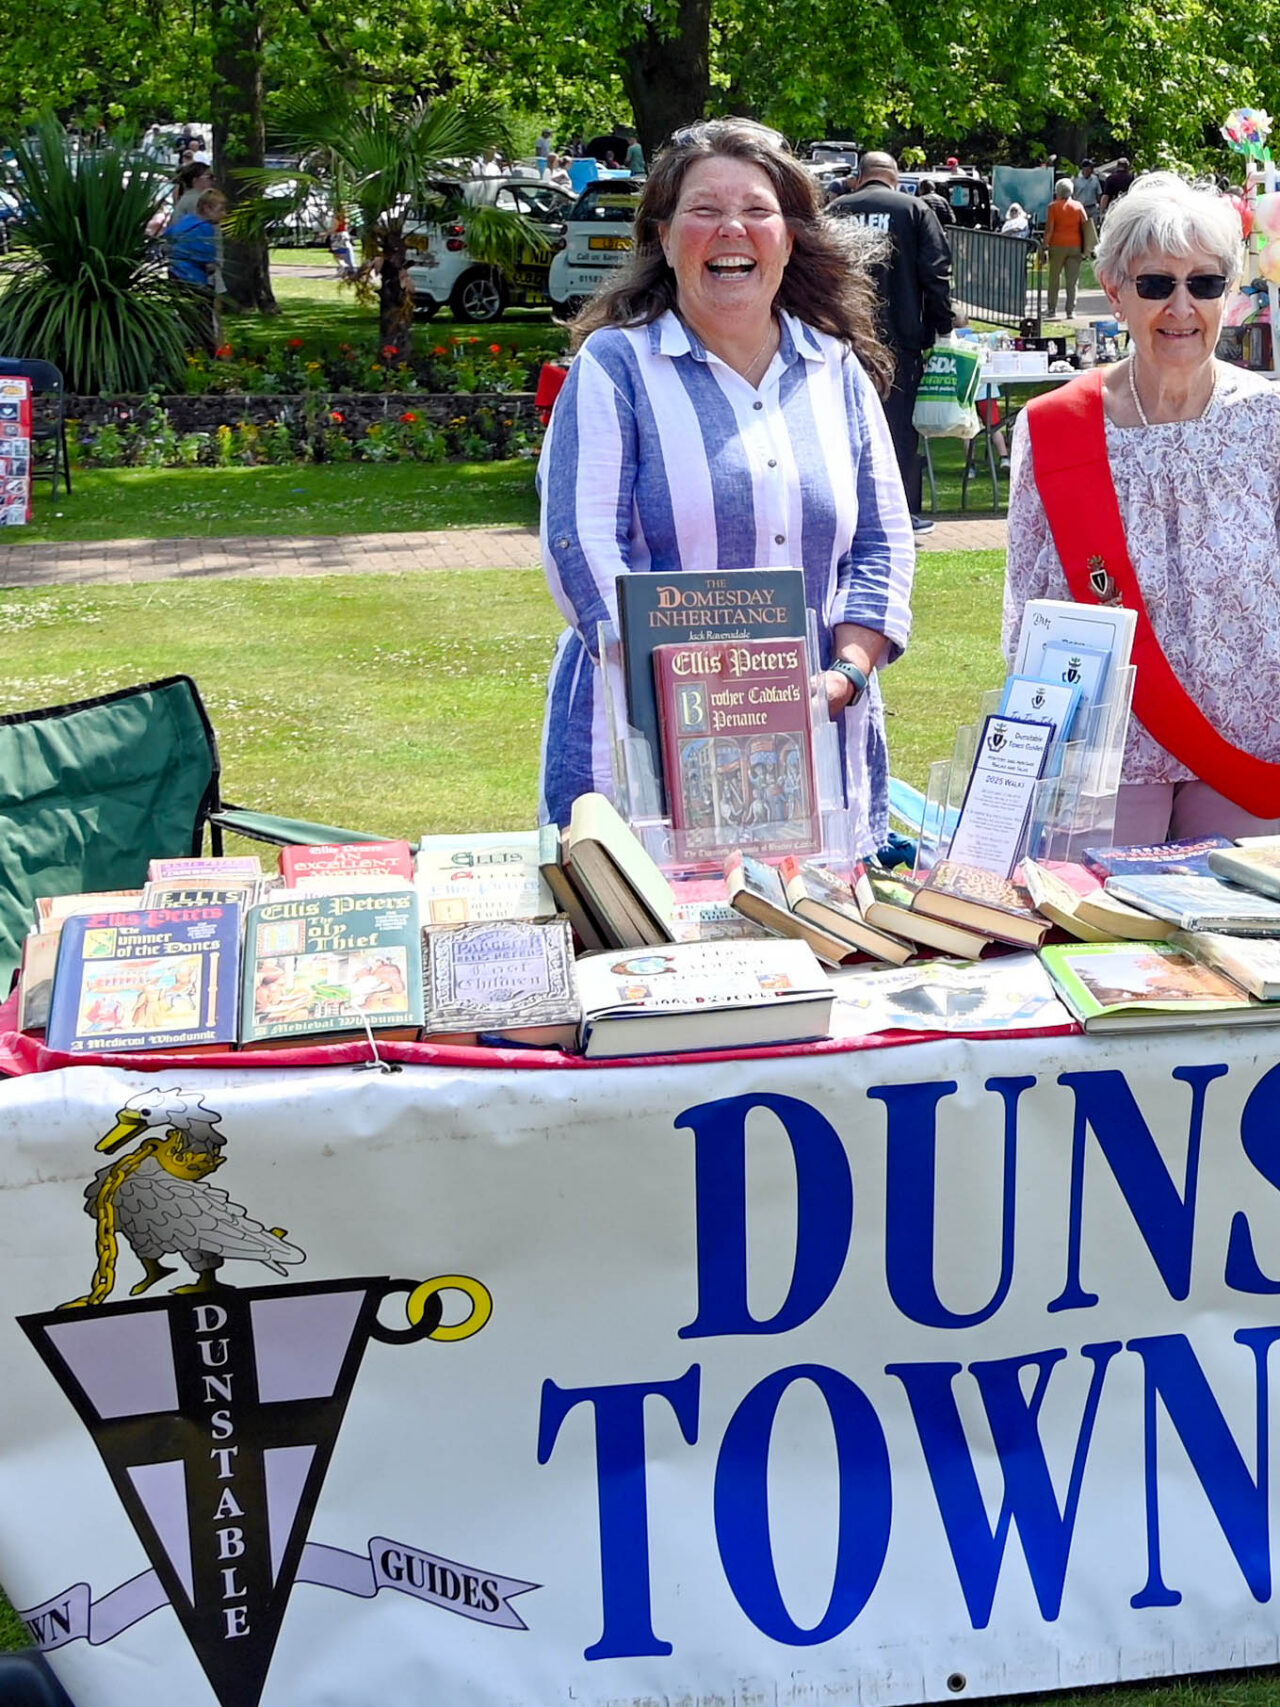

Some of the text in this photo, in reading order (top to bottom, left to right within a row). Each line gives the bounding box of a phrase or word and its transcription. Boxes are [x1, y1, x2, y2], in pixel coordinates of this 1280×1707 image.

[705, 579, 727, 588] THE
[656, 585, 775, 609] DOMESDAY
[649, 607, 788, 628] INHERITANCE
[688, 629, 750, 641] Jack Ravensdale
[671, 649, 799, 677] Ellis Peters
[748, 684, 800, 703] Cadfael's
[712, 711, 768, 731] Penance
[334, 852, 361, 862] AN
[162, 892, 239, 902] ELLIS
[261, 895, 412, 920] Ellis Peters
[84, 908, 223, 928] Ellis Peters
[117, 946, 131, 957] of
[136, 944, 160, 955] the
[308, 932, 380, 951] Thief
[270, 1020, 334, 1033] Medieval
[88, 1036, 145, 1048] Medieval
[149, 1030, 217, 1044] Whodunnit
[192, 1304, 252, 1640] DUNSTABLE
[380, 1549, 502, 1613] GUIDES
